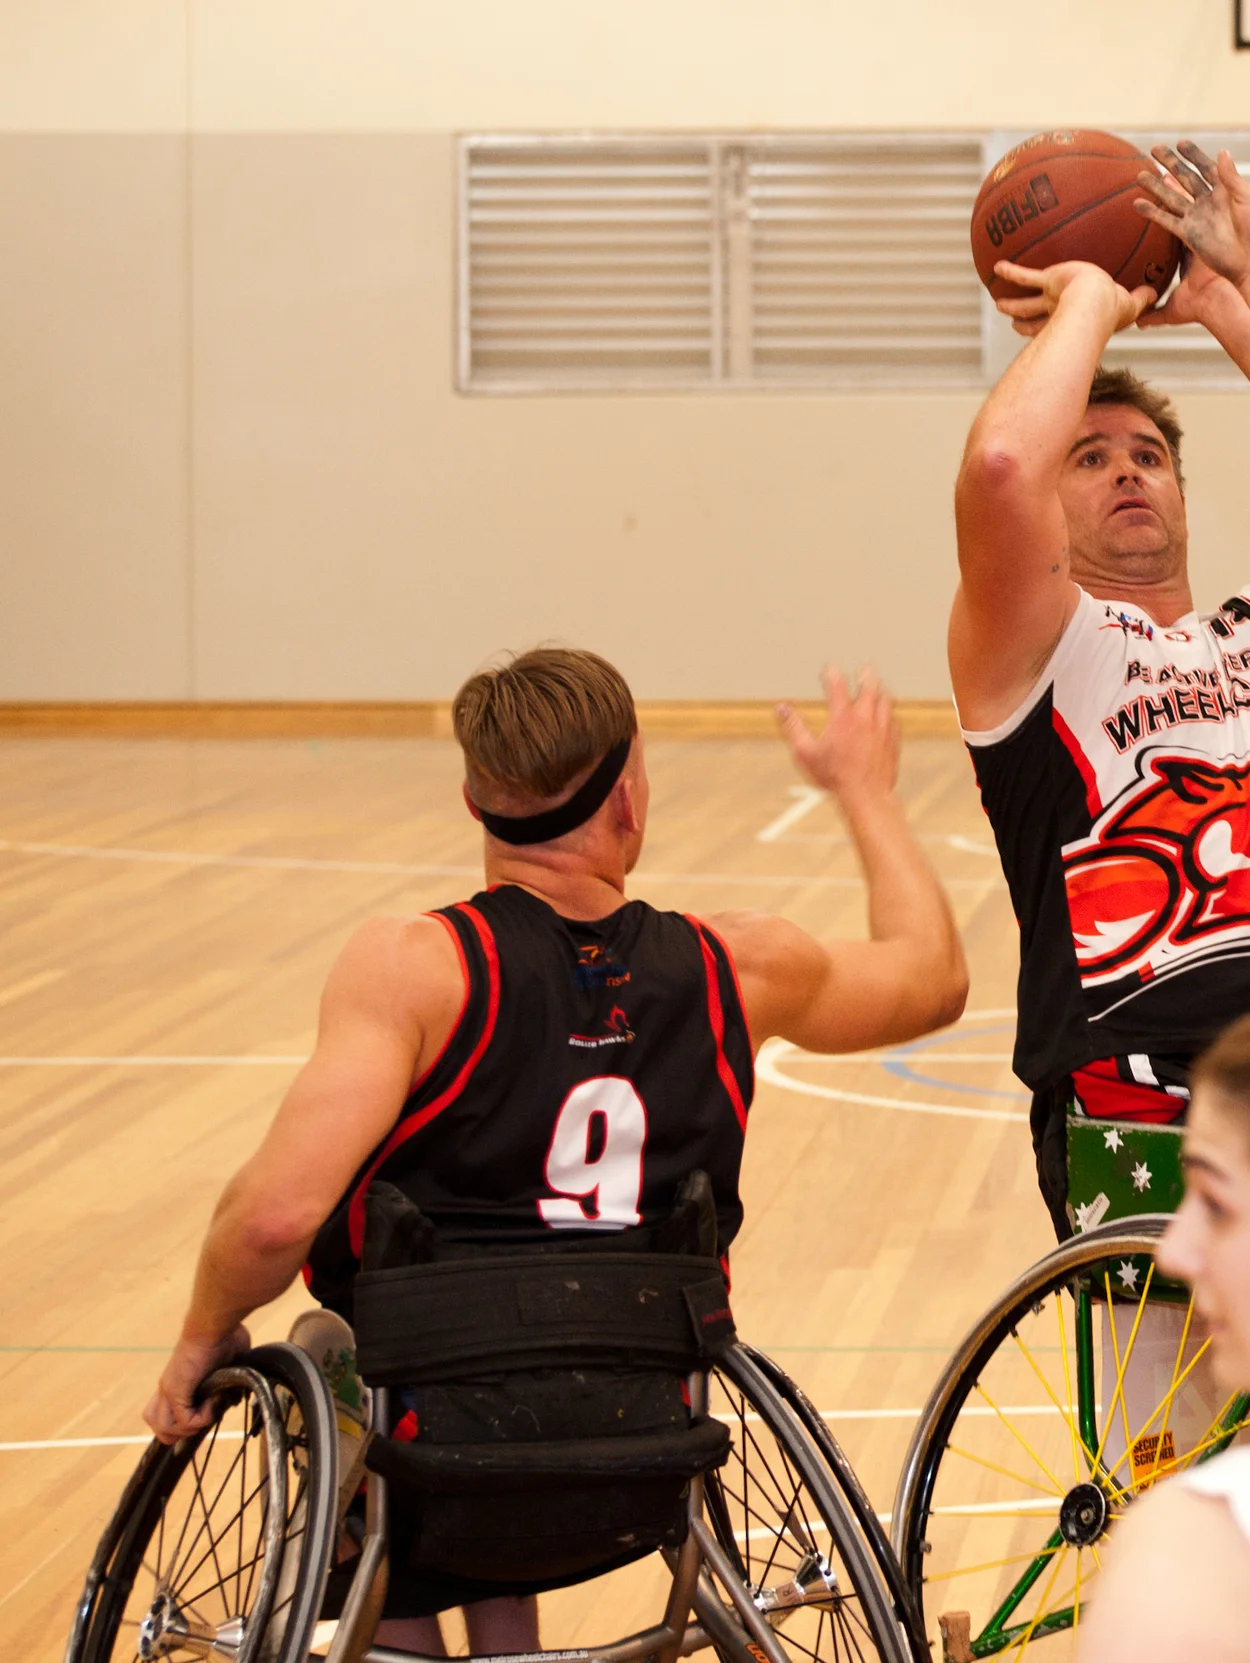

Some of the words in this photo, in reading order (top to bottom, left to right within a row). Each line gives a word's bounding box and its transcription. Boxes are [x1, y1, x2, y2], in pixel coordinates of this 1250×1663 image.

[985, 190, 1039, 248] FIBA
[537, 1074, 648, 1230] 9
[1133, 1431, 1173, 1454] SECURTY
[1134, 1446, 1175, 1467] SCRENED
